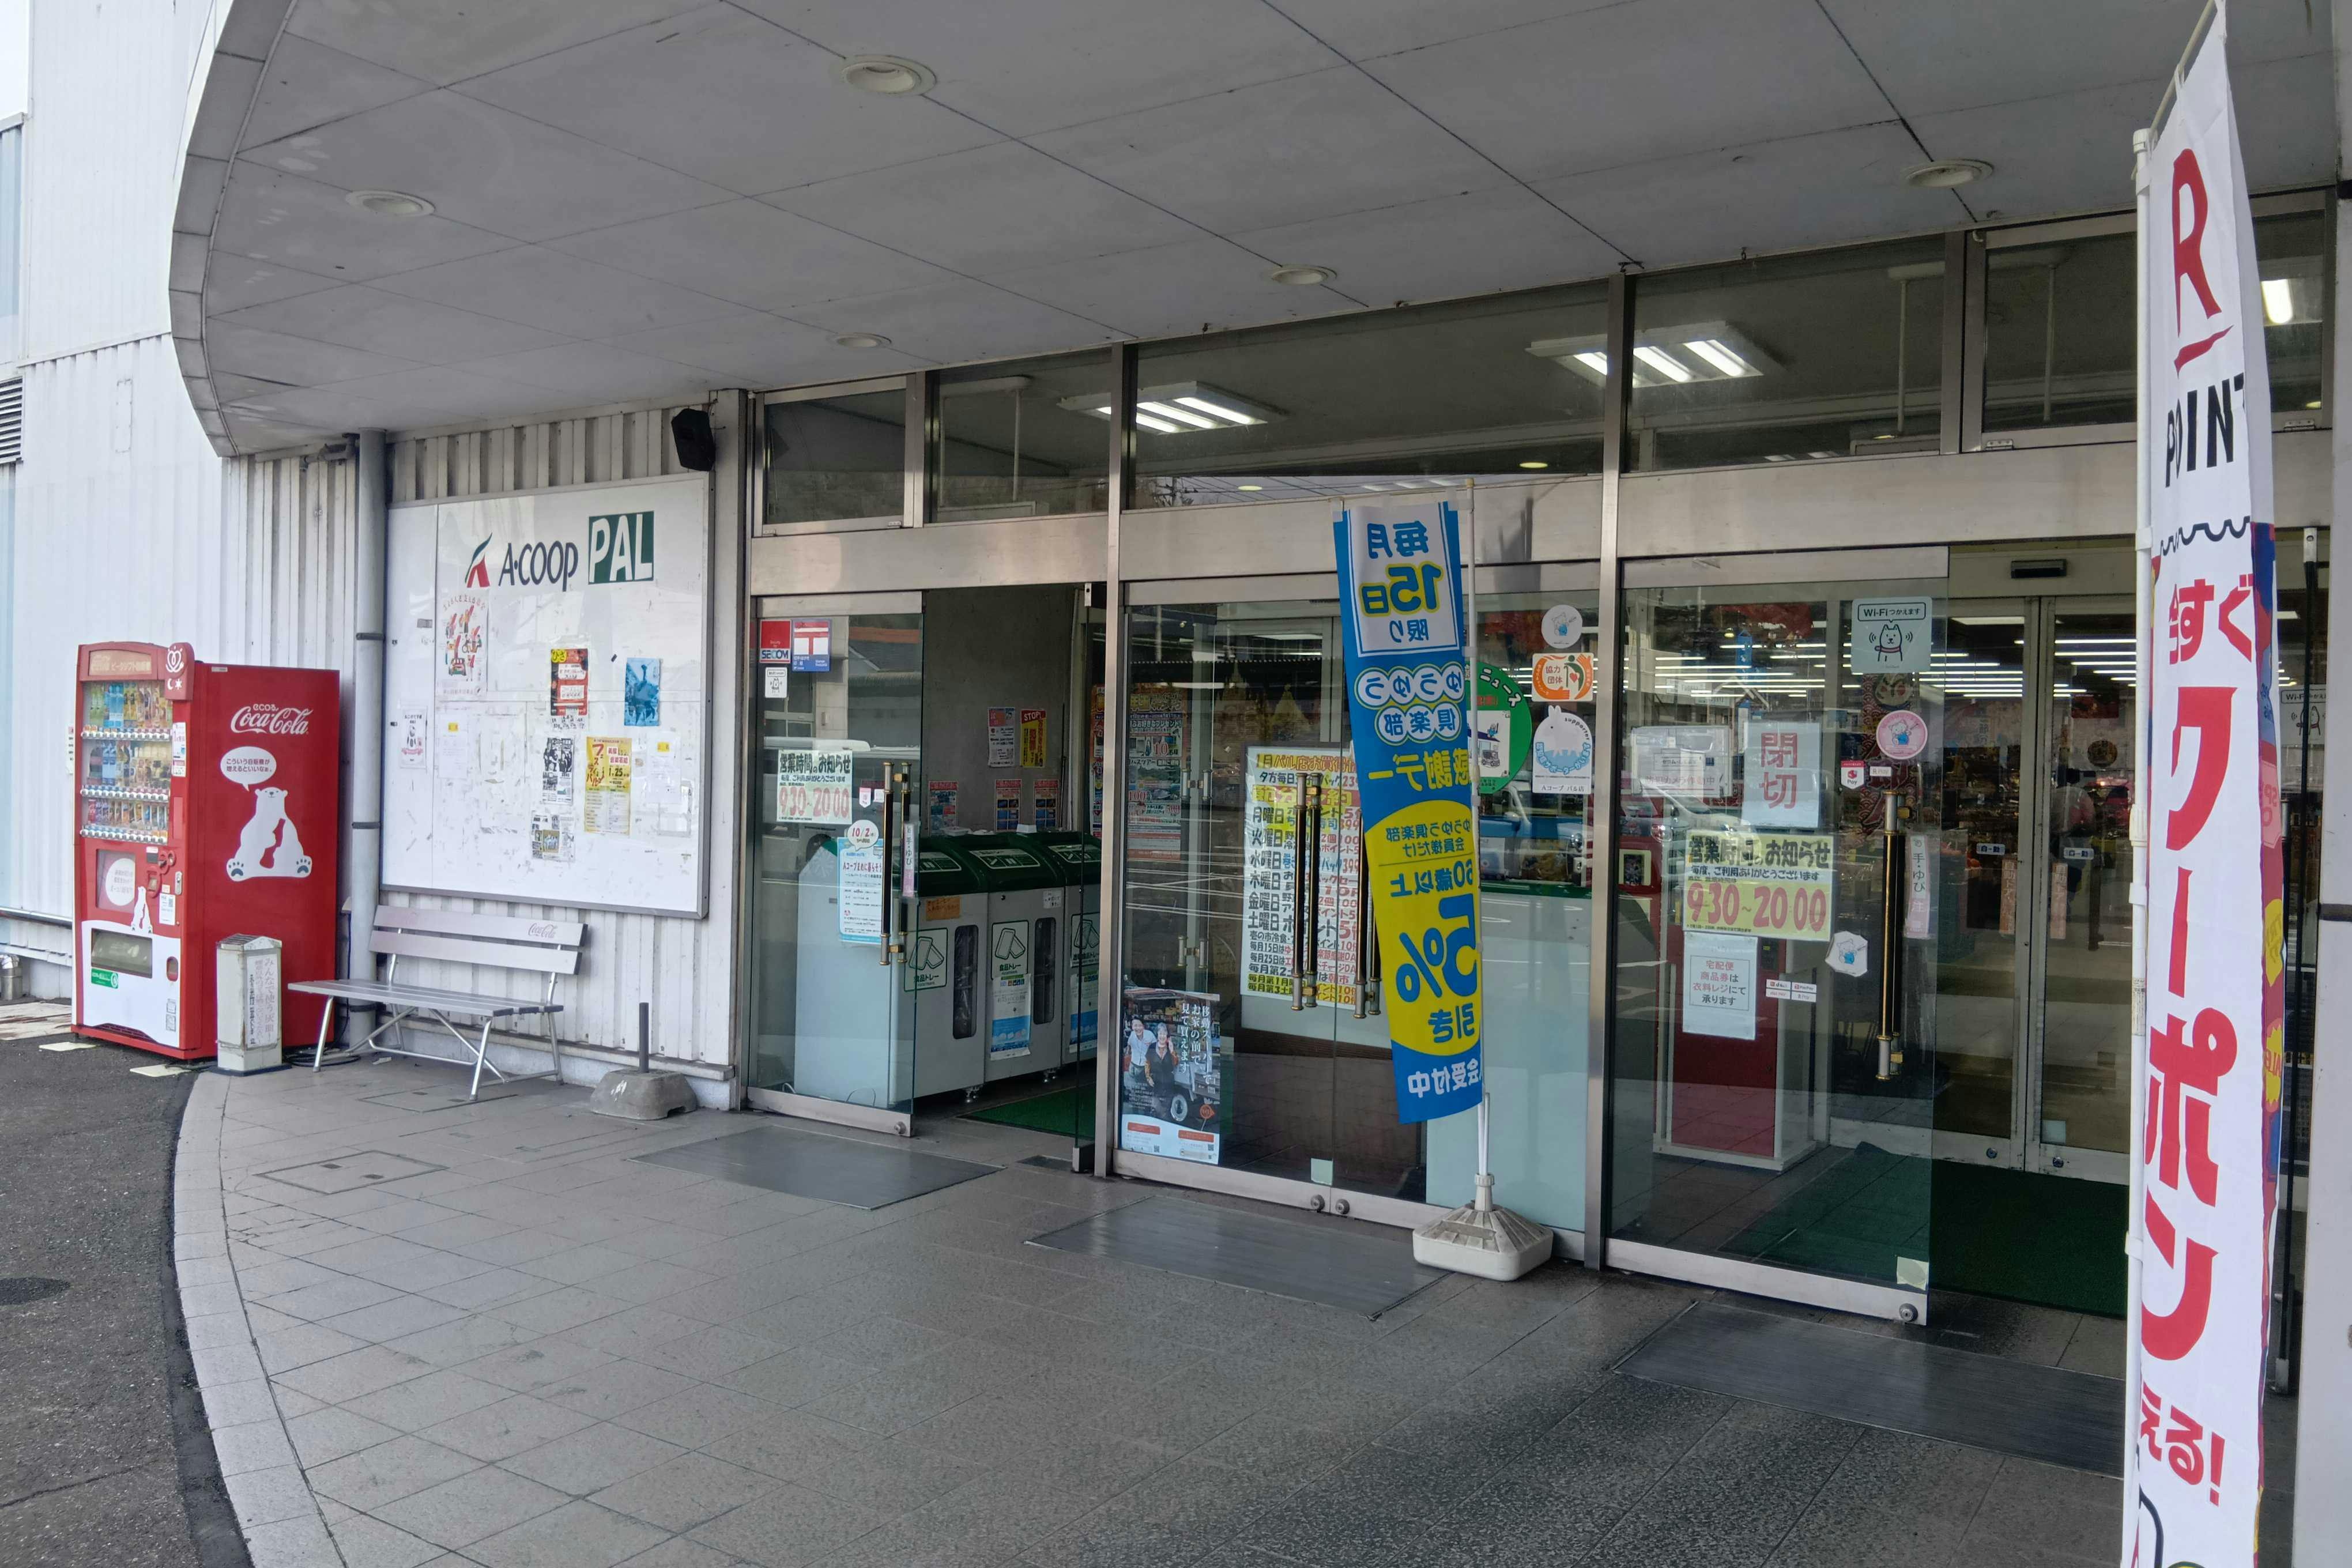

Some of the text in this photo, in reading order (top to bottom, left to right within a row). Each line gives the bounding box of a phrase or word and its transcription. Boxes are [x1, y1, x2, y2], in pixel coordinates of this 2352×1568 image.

[589, 514, 653, 583] PAL
[762, 649, 789, 659] SECOM
[1546, 666, 1560, 674] 協力
[1547, 676, 1563, 684] 団体
[1565, 717, 1590, 740] supporter
[780, 753, 851, 774] 営業時間のお知らせ
[1759, 732, 1798, 809] 閉切
[1253, 806, 1284, 824] 月曜日
[852, 828, 869, 837] 10/2
[1252, 828, 1283, 847] 火曜日
[1250, 850, 1281, 869] 水曜日
[1689, 835, 1830, 869] 営業時間のお知らせ
[1250, 871, 1281, 891] 木曜日
[1249, 892, 1280, 912] 金曜日
[1248, 911, 1279, 932] 土曜日
[999, 963, 1022, 972] 食品トレー
[1706, 960, 1734, 971] 宅配便
[1700, 971, 1739, 983] 商品券は
[1693, 983, 1746, 996] 衣料レジにて
[1702, 994, 1736, 1005] 承ります
[2141, 687, 2238, 1362] クーポン
